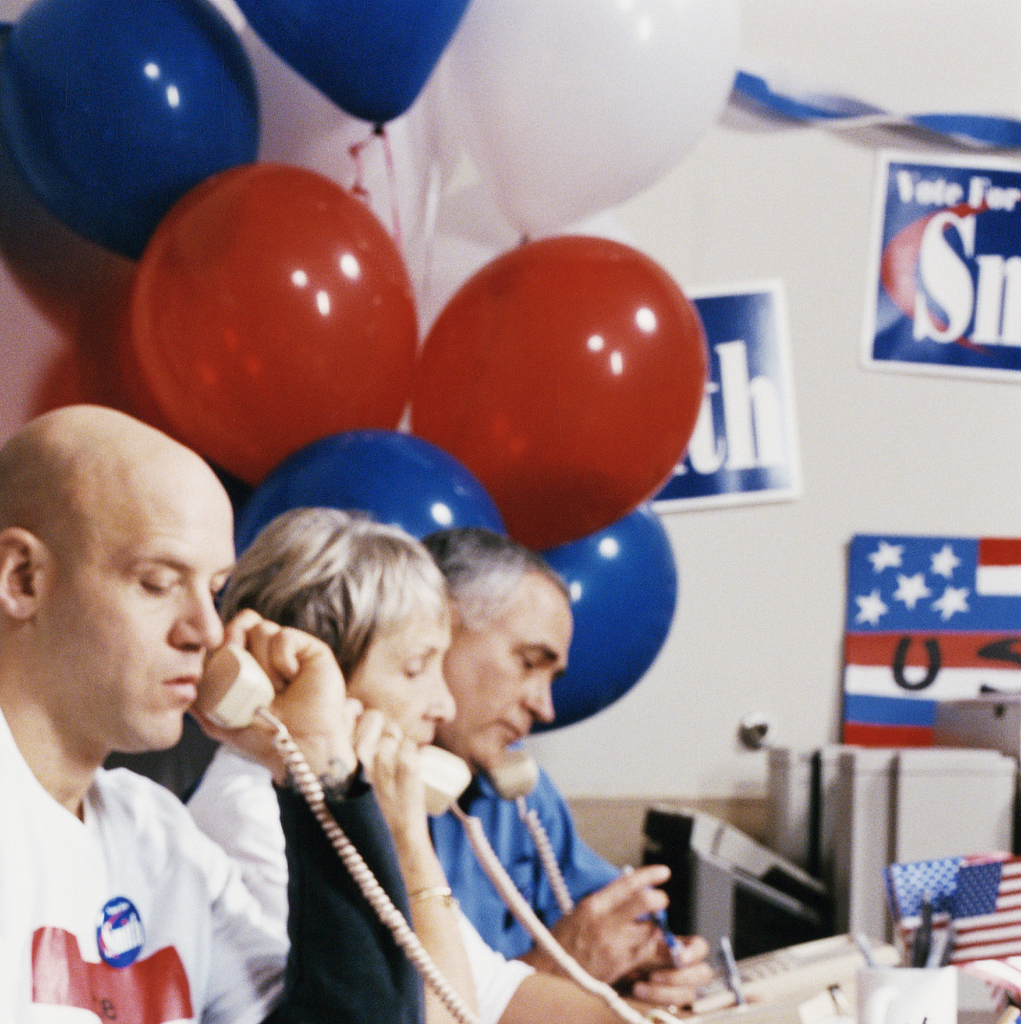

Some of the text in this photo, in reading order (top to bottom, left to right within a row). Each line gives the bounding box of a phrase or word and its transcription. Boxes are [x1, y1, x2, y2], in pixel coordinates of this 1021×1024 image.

[896, 169, 1021, 212] Vote For
[673, 339, 780, 475] th
